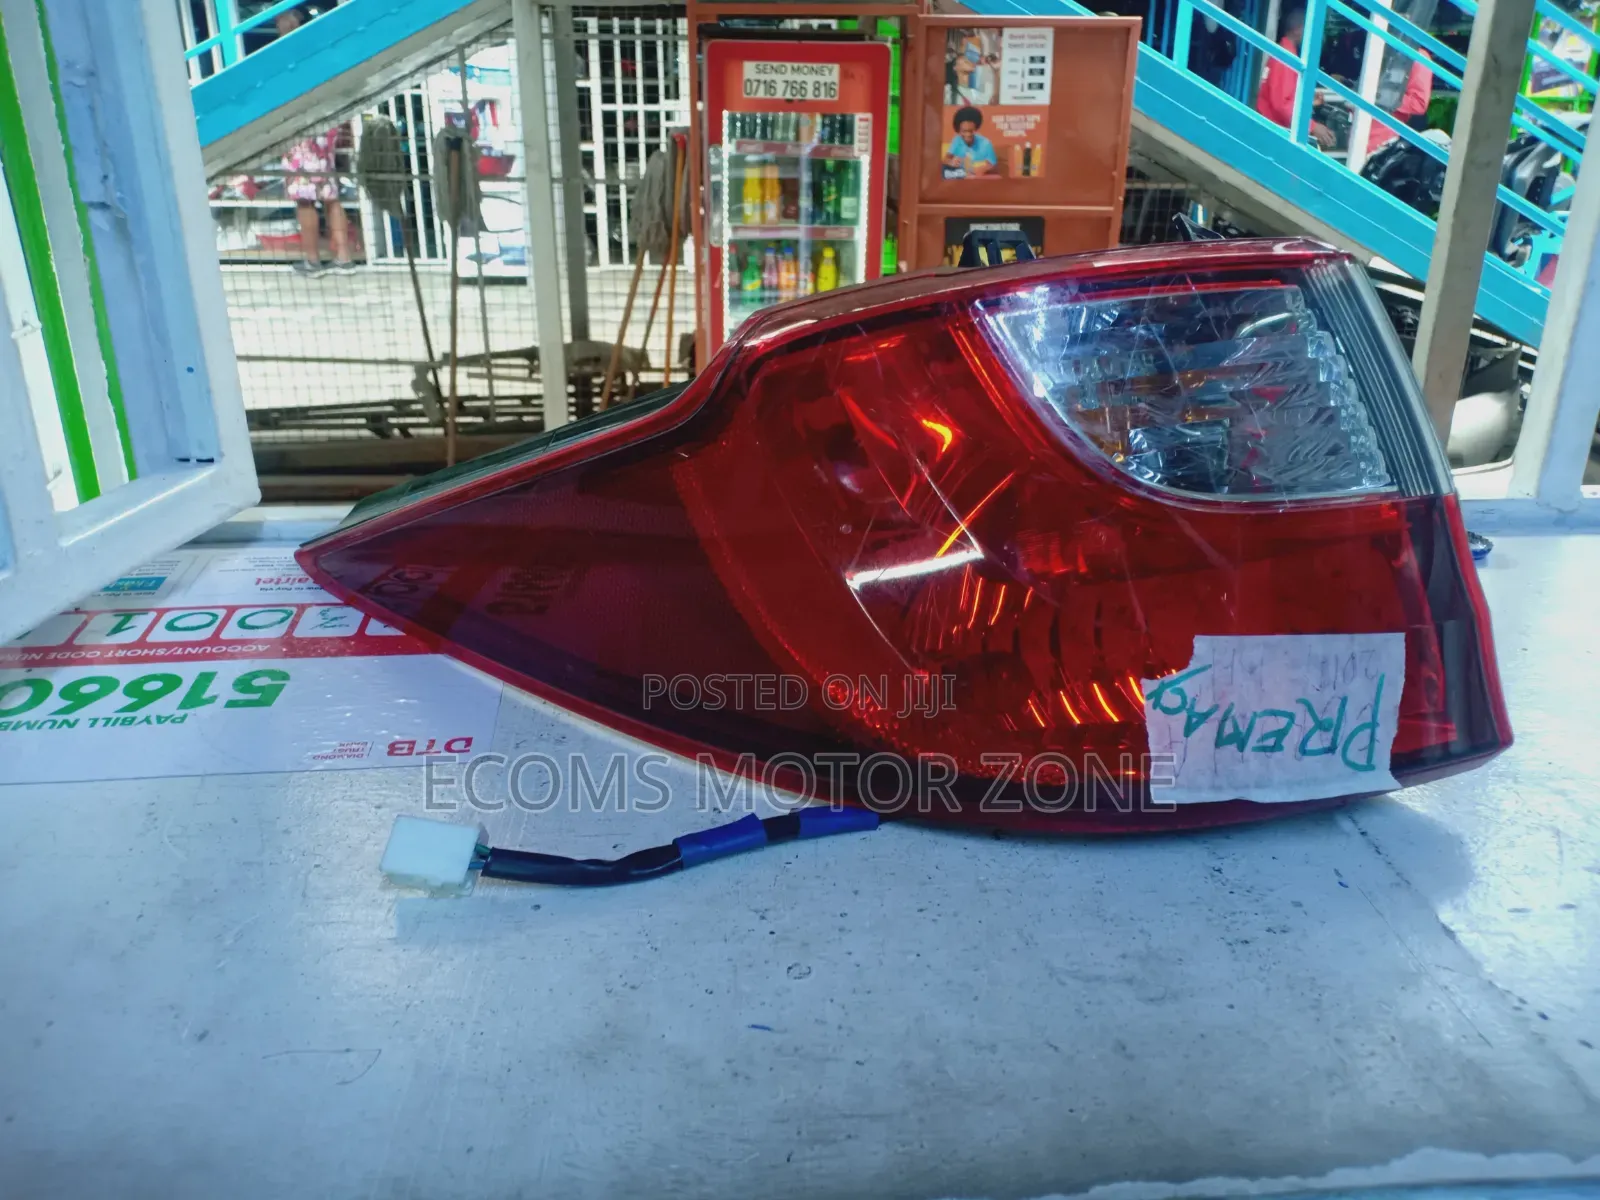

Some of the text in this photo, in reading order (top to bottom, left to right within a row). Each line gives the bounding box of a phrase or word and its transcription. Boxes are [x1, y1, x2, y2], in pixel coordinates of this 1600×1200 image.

[755, 63, 788, 75] SEND
[791, 65, 834, 76] MONEY
[744, 79, 837, 98] 0716 766 816
[255, 577, 311, 586] airtel
[46, 651, 101, 660] CODE
[104, 644, 271, 659] ACCOUNT/SHORT
[88, 713, 188, 729] PAYBILL
[386, 736, 474, 756] DTB
[312, 753, 365, 761] DIAMOND
